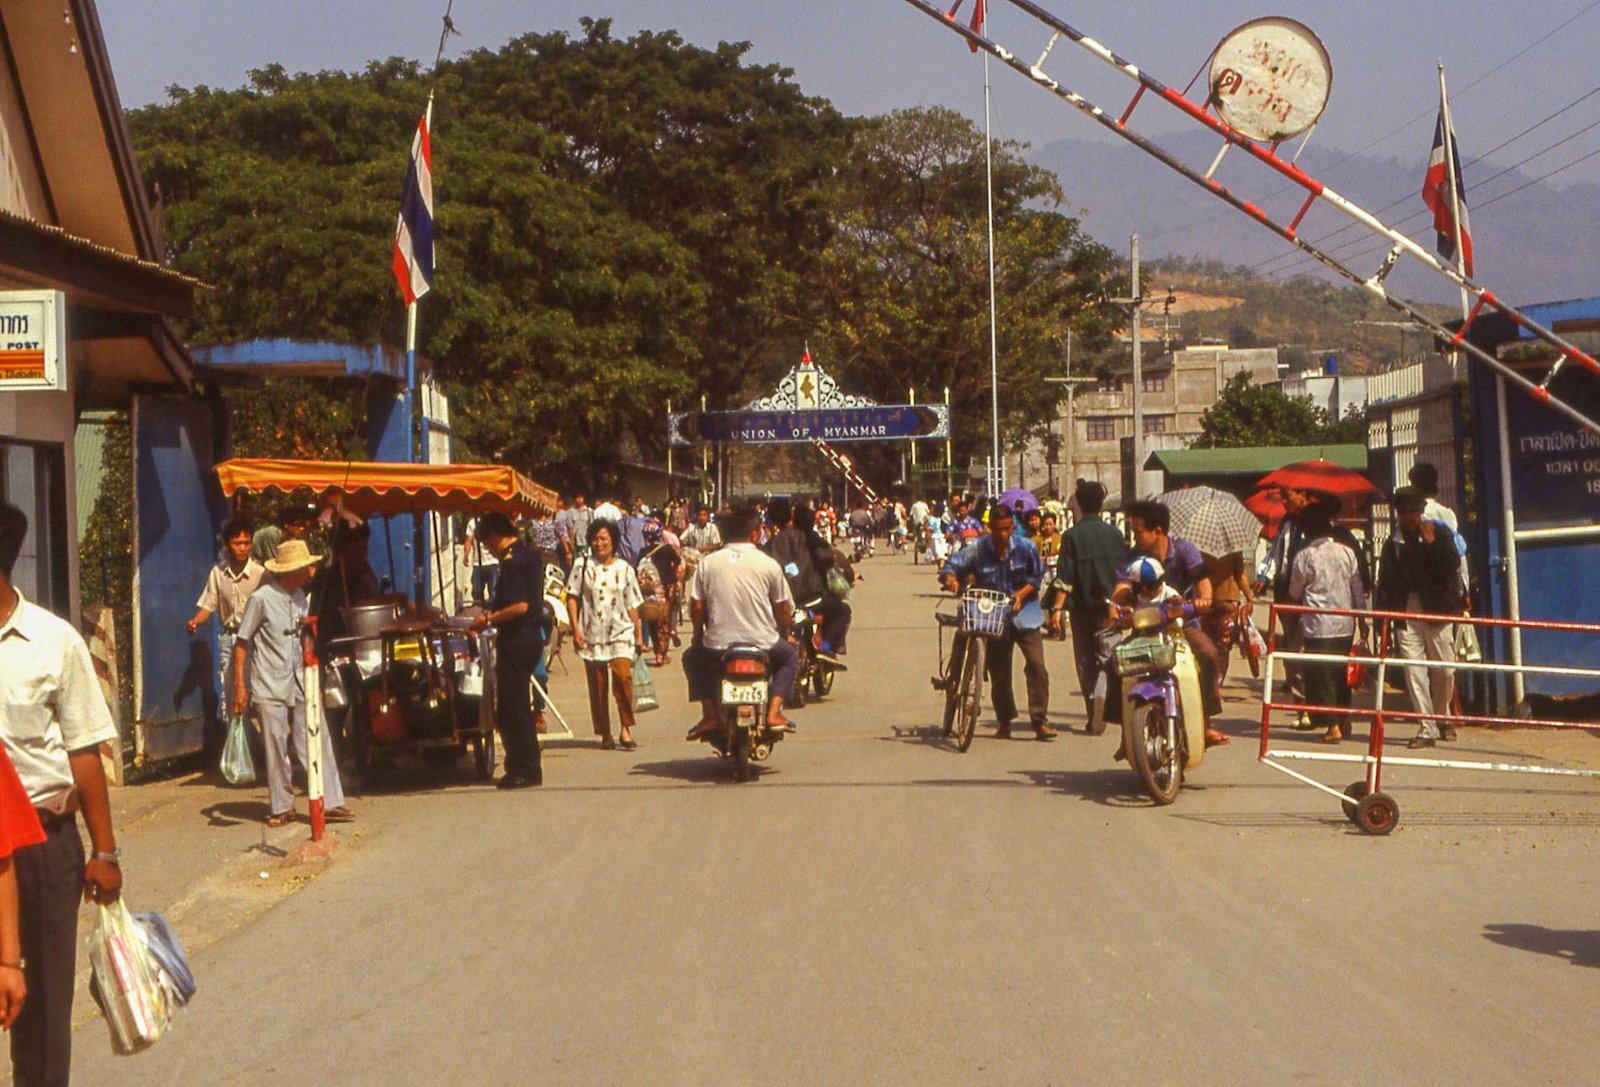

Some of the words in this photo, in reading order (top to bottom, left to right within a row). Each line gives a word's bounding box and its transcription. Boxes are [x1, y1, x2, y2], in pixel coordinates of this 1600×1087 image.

[8, 342, 39, 350] POST
[731, 429, 776, 440] UNION
[792, 427, 810, 438] OF
[824, 425, 887, 437] MYANMAR
